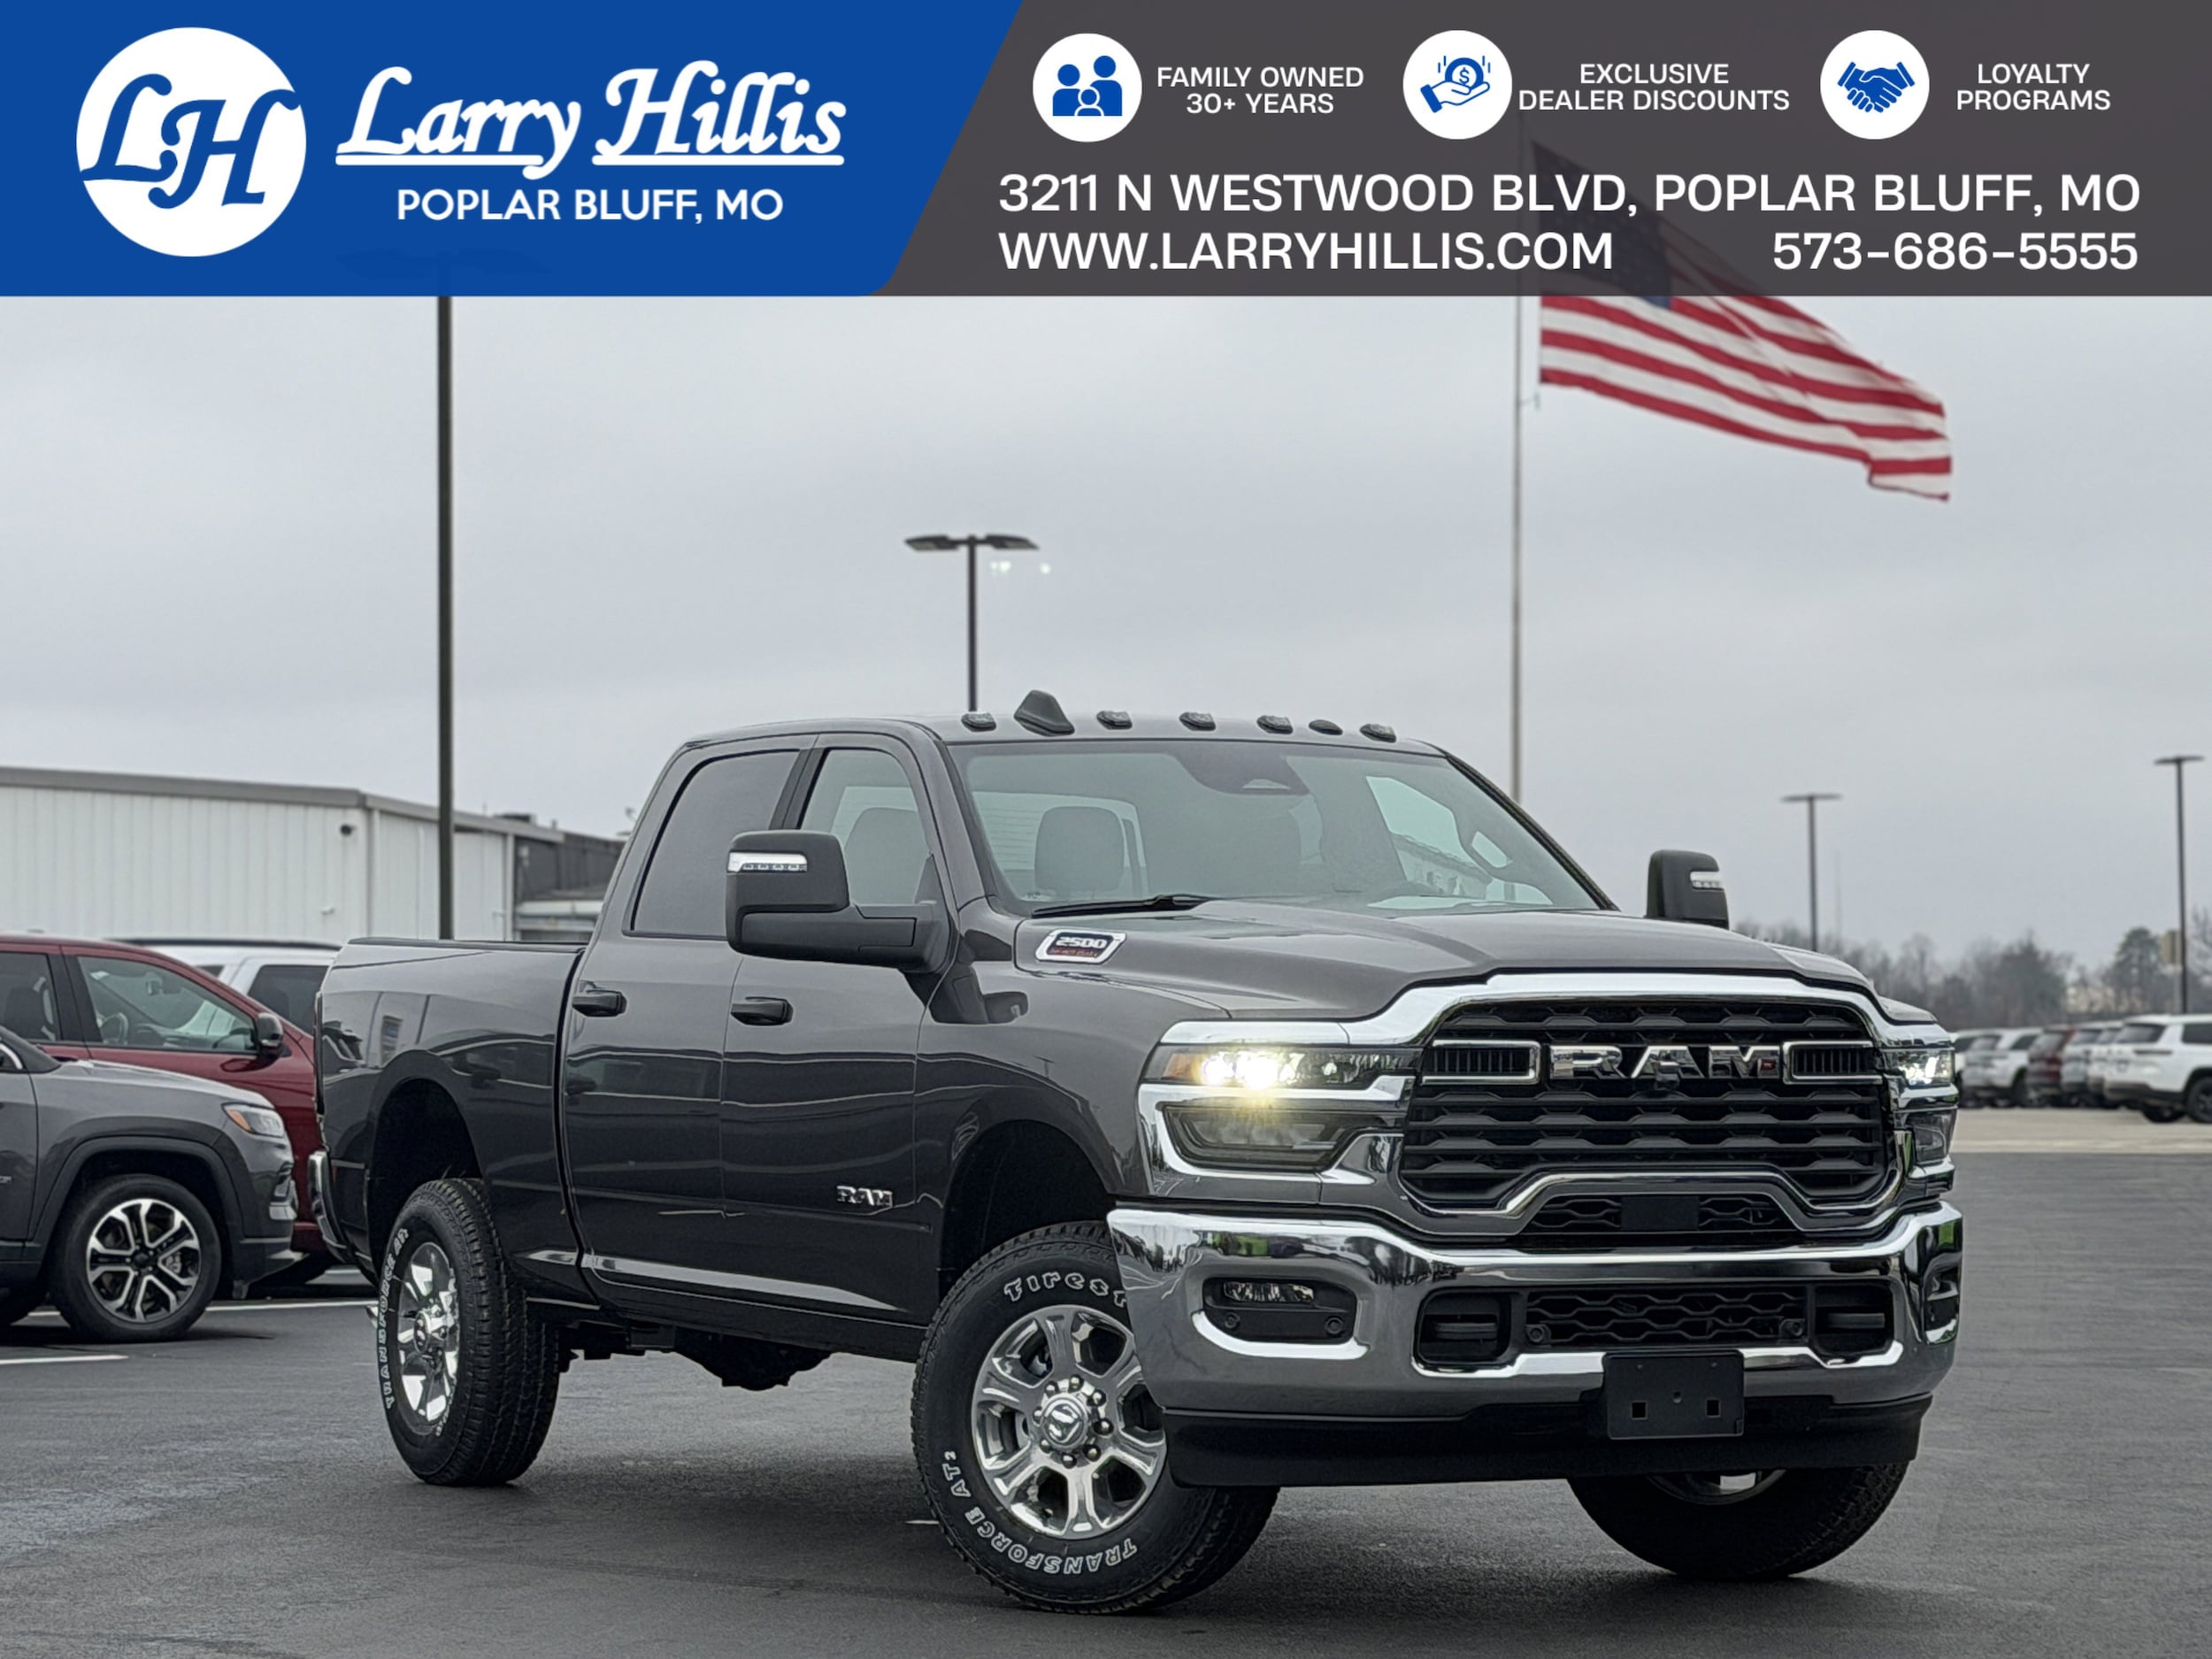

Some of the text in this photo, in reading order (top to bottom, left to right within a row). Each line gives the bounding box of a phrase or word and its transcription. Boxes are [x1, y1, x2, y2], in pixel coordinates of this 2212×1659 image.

[1056, 936, 1107, 949] 2500
[1549, 1045, 1780, 1079] RAM
[836, 1186, 893, 1207] RAM
[964, 1507, 1138, 1575] TRANSFORCE
